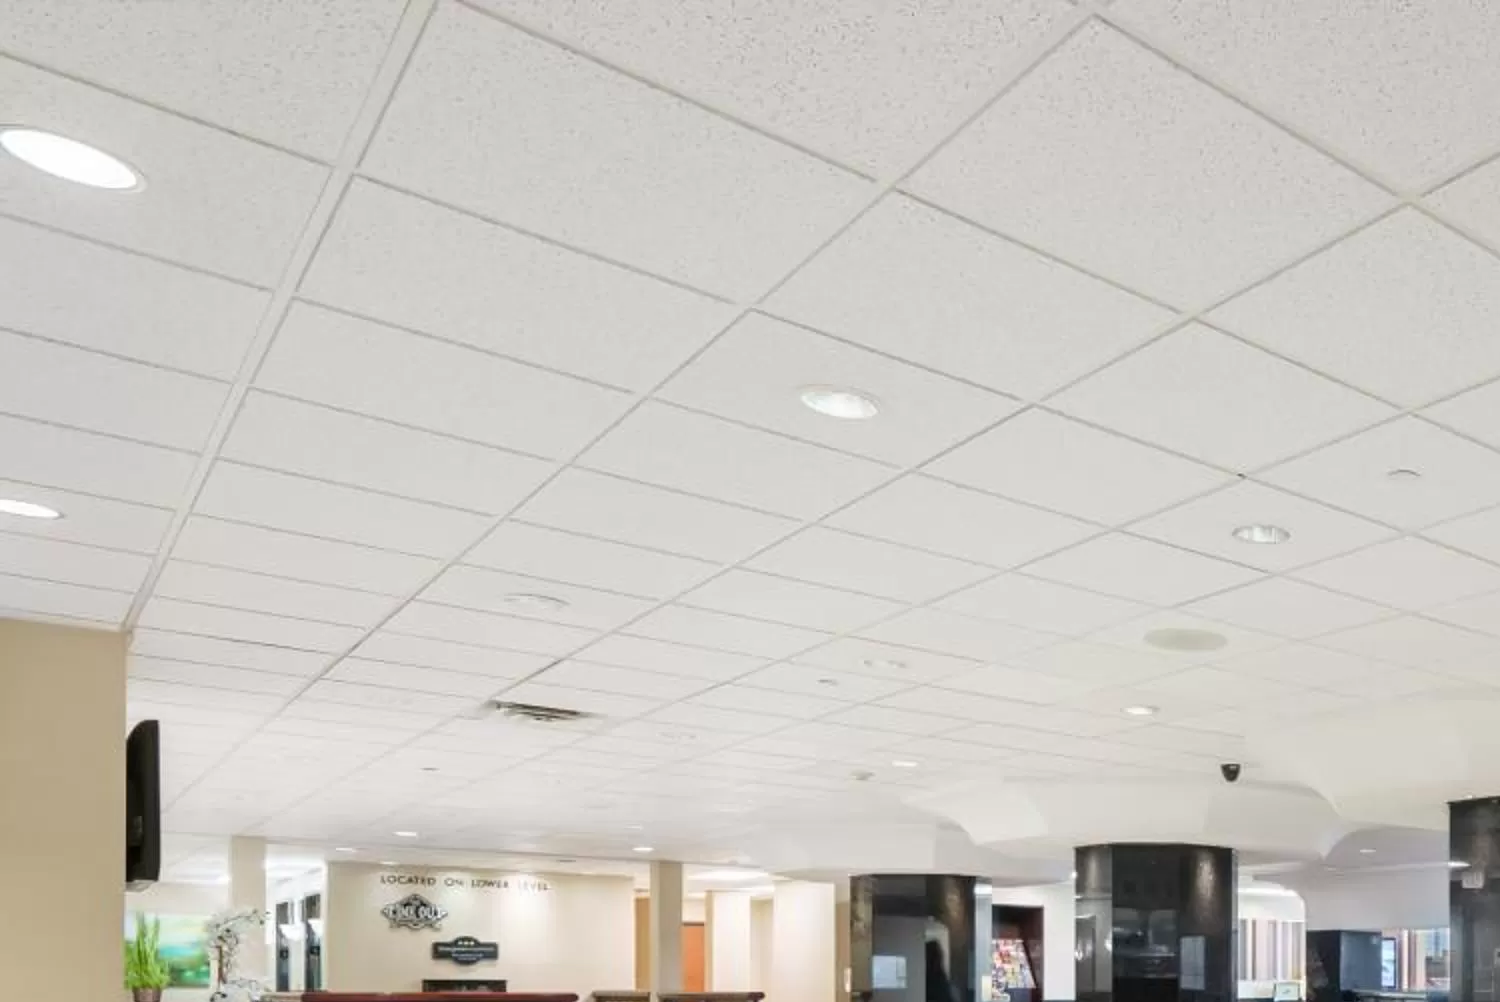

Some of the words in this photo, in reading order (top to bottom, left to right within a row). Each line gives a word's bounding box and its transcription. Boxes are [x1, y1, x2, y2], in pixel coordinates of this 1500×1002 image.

[379, 875, 437, 887] LOCATED
[444, 877, 465, 888] ON
[471, 879, 509, 889] LOWER
[517, 880, 553, 891] LEVEL
